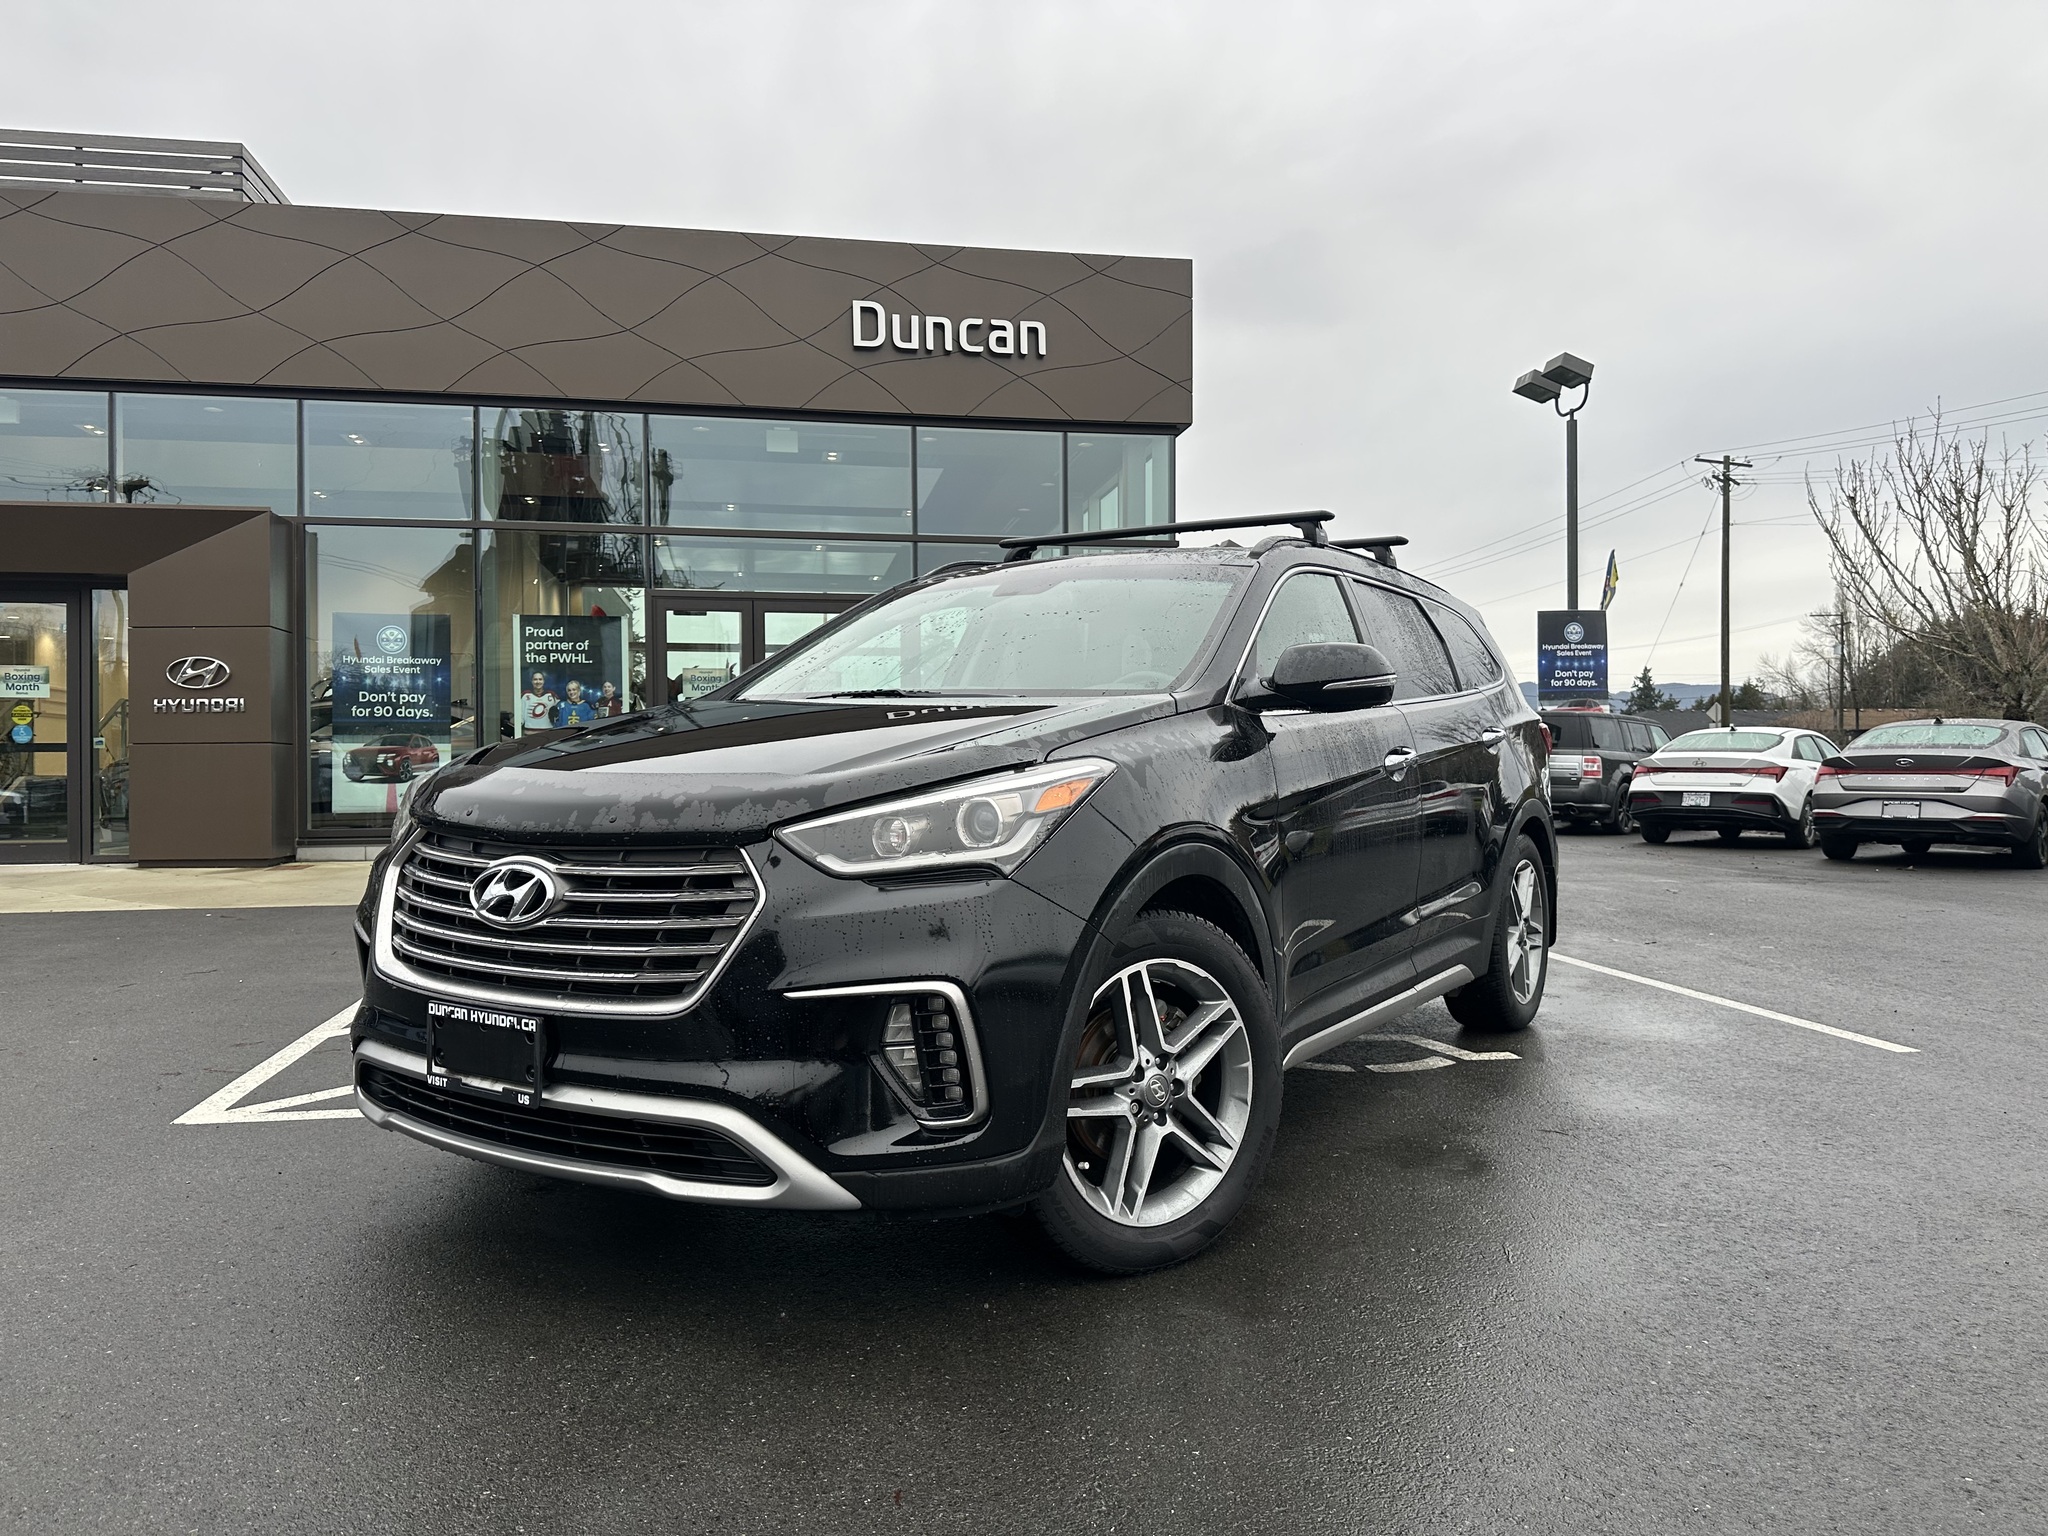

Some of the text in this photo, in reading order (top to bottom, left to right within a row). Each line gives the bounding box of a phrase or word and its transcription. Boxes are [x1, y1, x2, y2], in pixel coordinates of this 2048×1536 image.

[852, 299, 1047, 356] Duncan
[525, 626, 564, 637] Proud
[525, 640, 590, 652] partner of
[342, 655, 442, 666] Hyundai Breakaway
[525, 652, 593, 664] the PWHL.
[364, 665, 421, 674] Sales Event
[1578, 671, 1594, 679] pay
[4, 672, 41, 682] Boxing
[690, 674, 722, 683] Boxing
[5, 683, 40, 691] Month
[1550, 679, 1598, 688] for 90 days.
[359, 691, 426, 705] Don't pay
[153, 697, 245, 713] HYUNDAI
[351, 705, 434, 719] for 90 days.
[428, 1002, 468, 1021] DUNCAN
[426, 1074, 530, 1105] VISIT US
